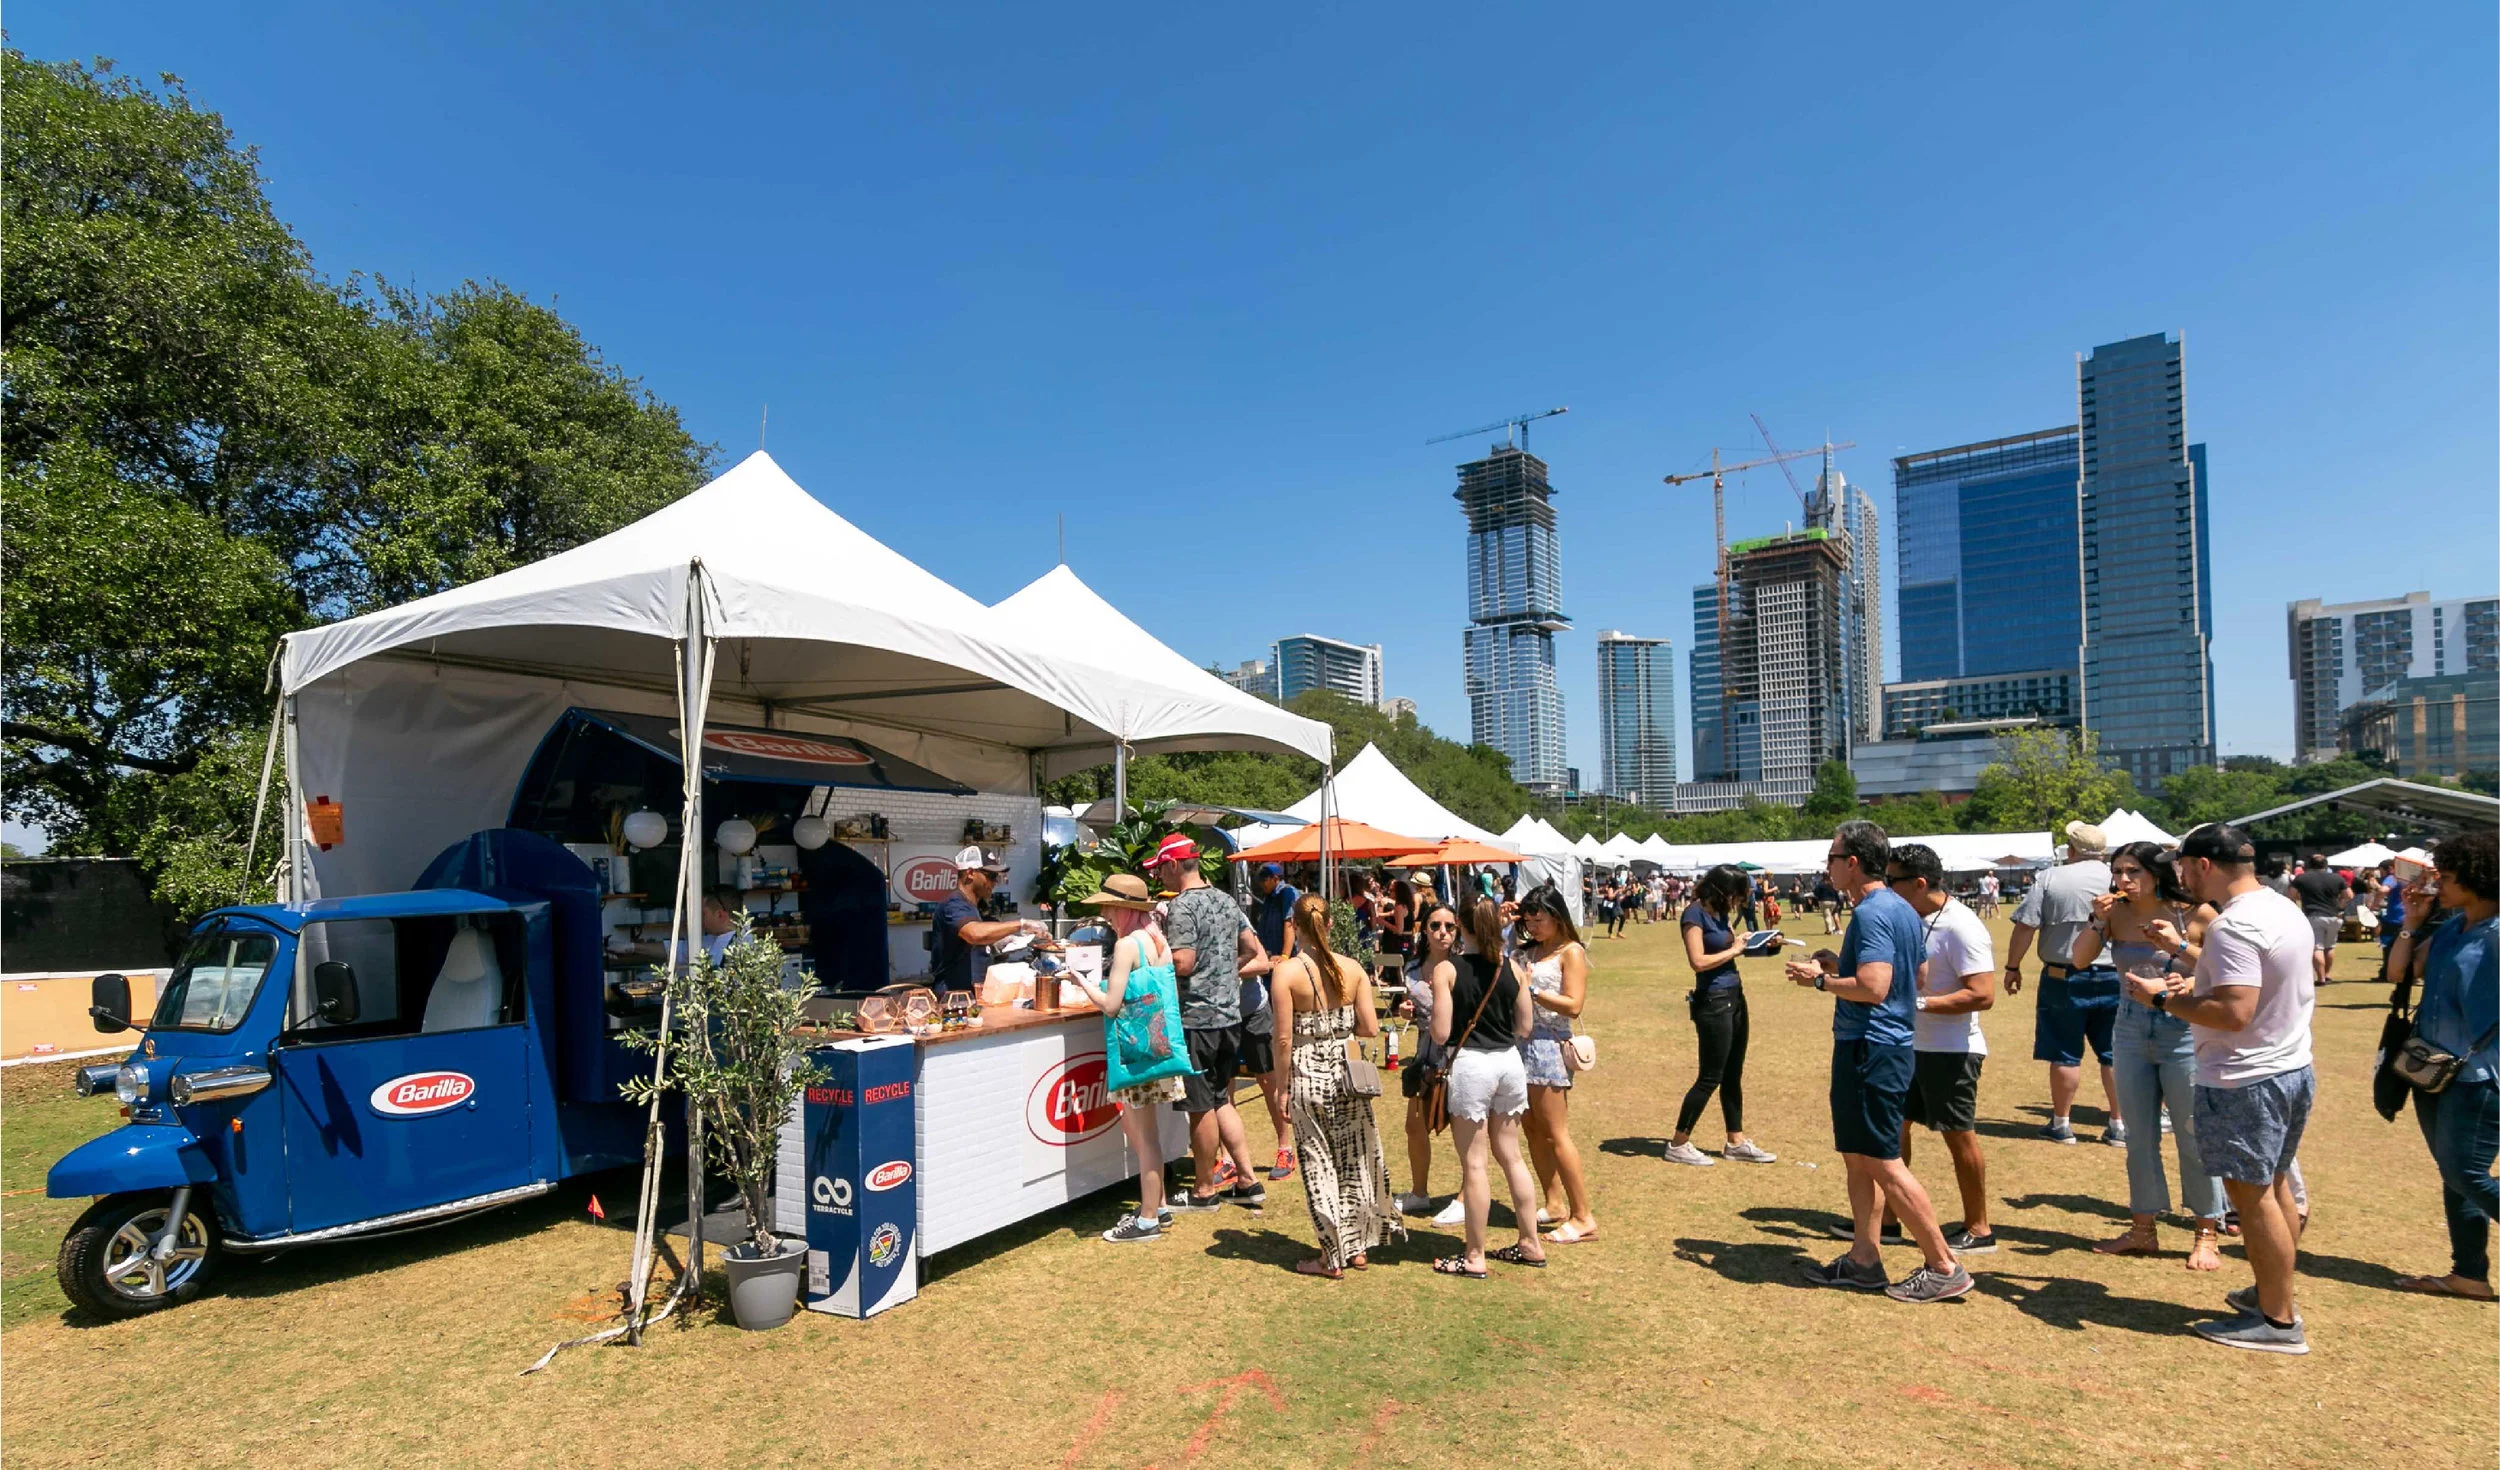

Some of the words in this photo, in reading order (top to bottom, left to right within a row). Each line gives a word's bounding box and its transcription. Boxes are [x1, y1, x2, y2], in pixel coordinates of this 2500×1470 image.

[723, 735, 858, 760] Barilla
[911, 868, 959, 891] Barilla
[396, 1078, 467, 1104] Barilla
[808, 1087, 854, 1104] RECYCLE
[865, 1081, 911, 1103] RECYCLE
[1054, 1071, 1108, 1121] Baril
[875, 1164, 909, 1185] Barilla
[812, 1204, 854, 1217] TERRACYCLE
